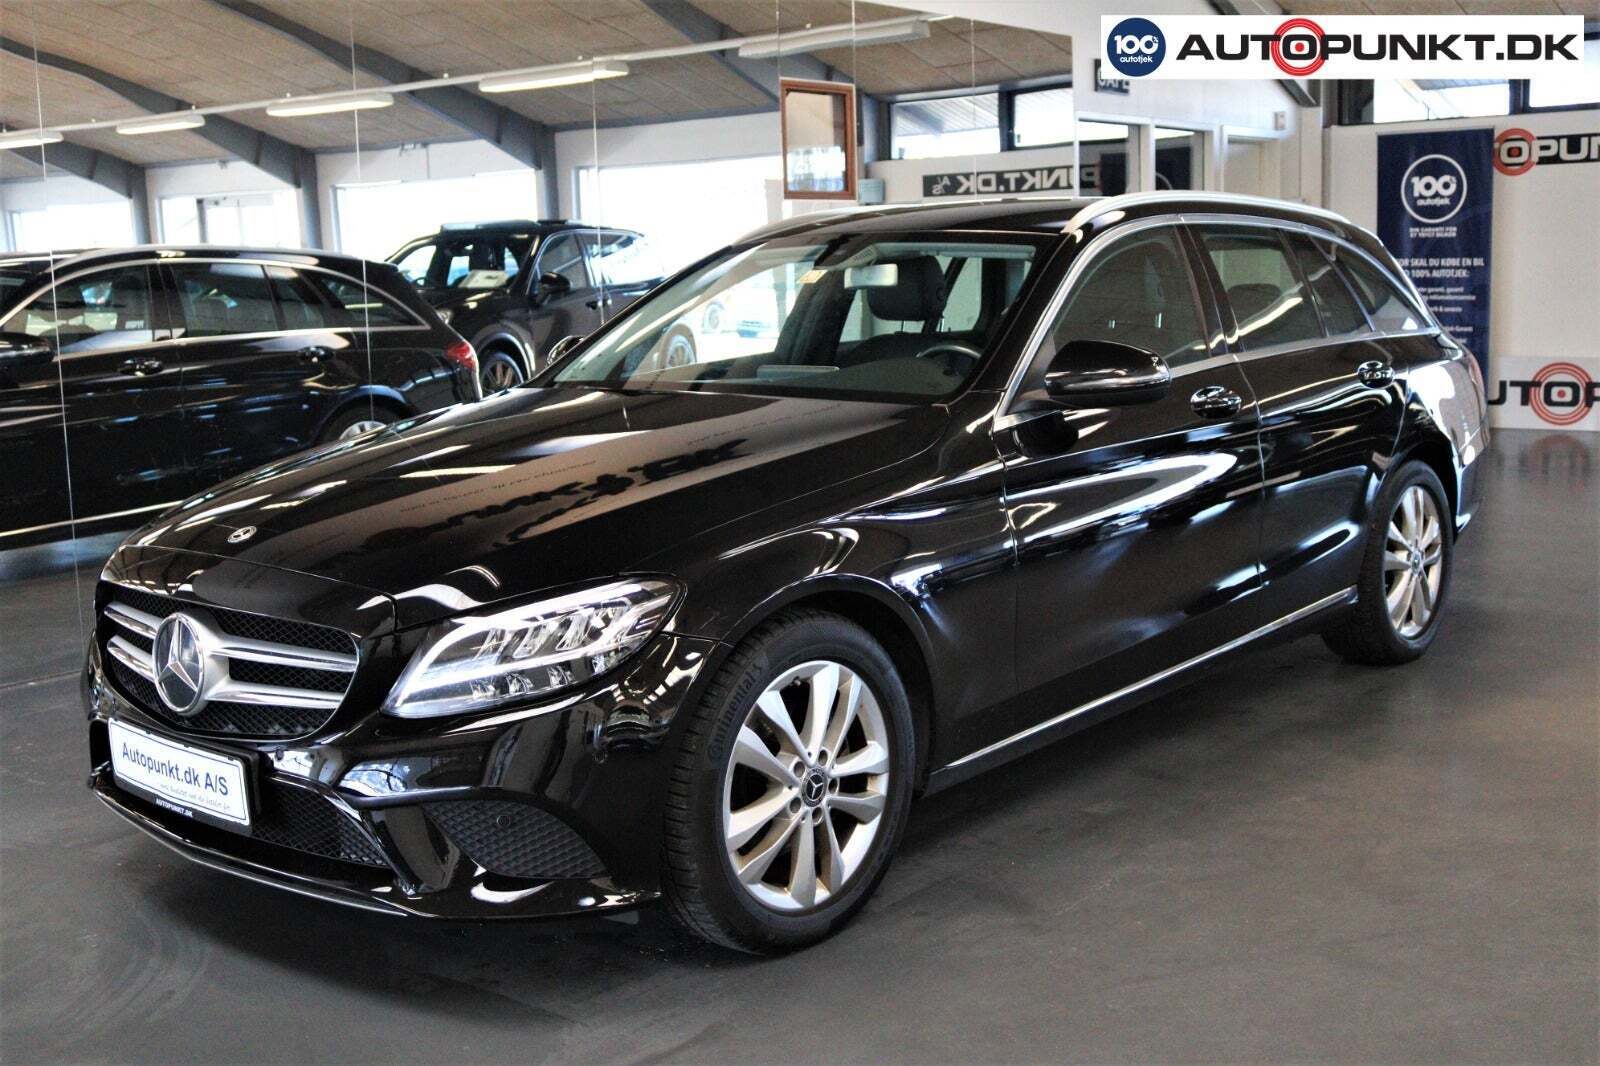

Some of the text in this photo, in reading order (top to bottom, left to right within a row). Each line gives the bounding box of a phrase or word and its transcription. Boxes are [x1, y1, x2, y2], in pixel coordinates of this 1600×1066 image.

[1494, 137, 1600, 163] OPU
[1410, 257, 1427, 266] SKAL
[1429, 257, 1439, 266] DU
[1462, 257, 1472, 266] EN
[1473, 257, 1485, 266] BIL
[122, 742, 201, 788] Autopunkt.dk
[204, 771, 229, 796] A/S
[155, 798, 193, 818] AUTOPUNKT.DK
